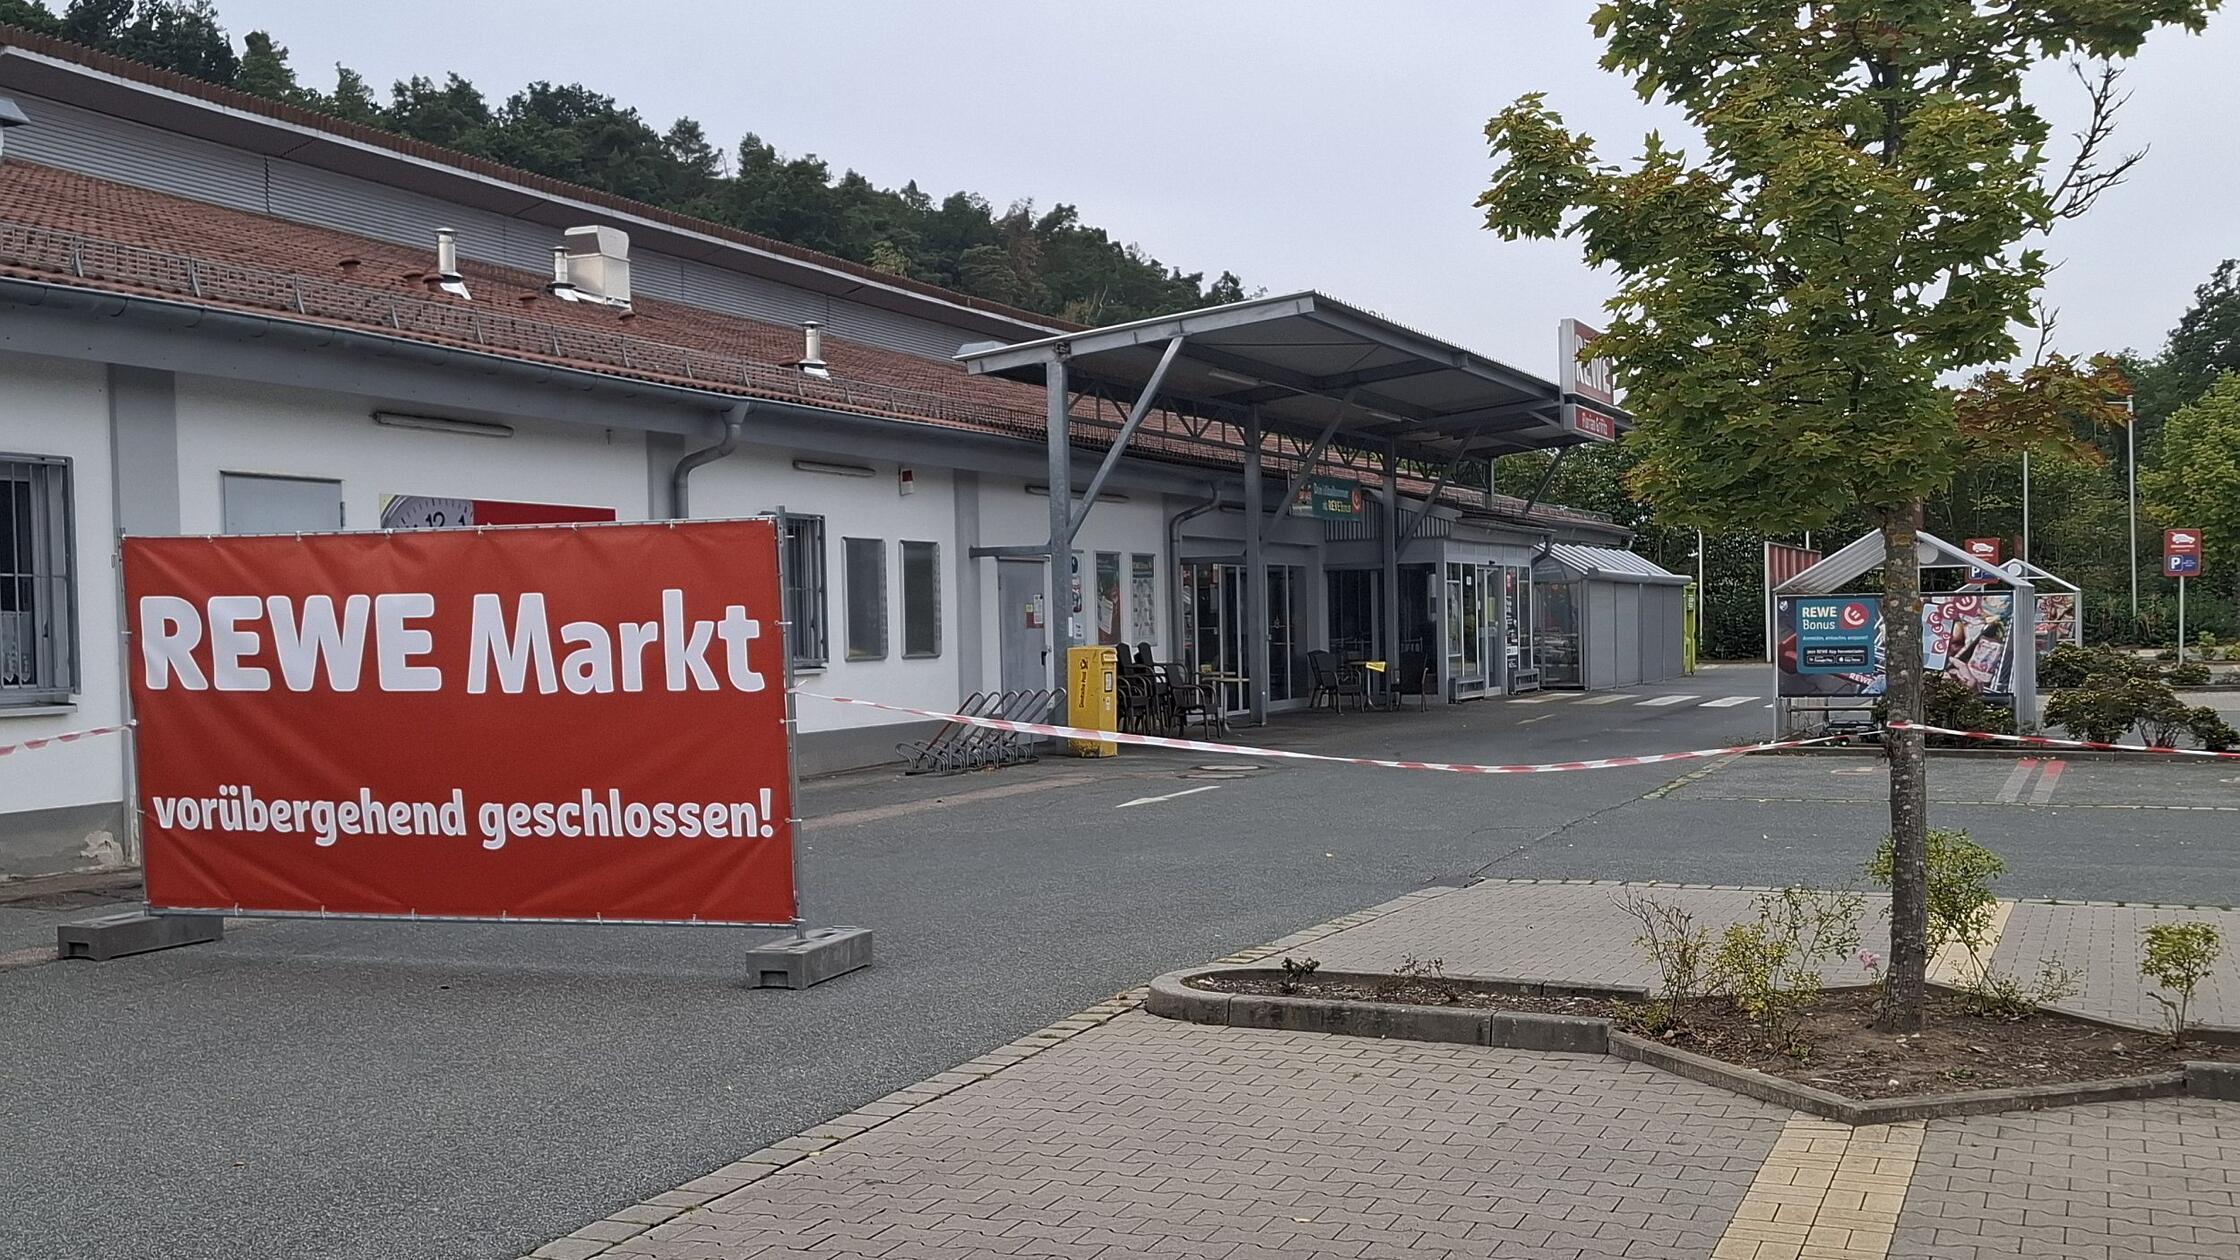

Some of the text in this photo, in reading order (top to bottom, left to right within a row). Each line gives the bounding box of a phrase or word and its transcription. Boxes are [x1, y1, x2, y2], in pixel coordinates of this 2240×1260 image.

[1576, 334, 1611, 394] REWE
[425, 511, 445, 527] 12
[2171, 557, 2181, 570] P
[1971, 566, 1981, 578] P
[1802, 606, 1838, 618] REWE
[1803, 619, 1836, 630] Bonus
[140, 589, 765, 695] REWE Markt
[153, 785, 773, 849] vorübergehend geschlossen!
